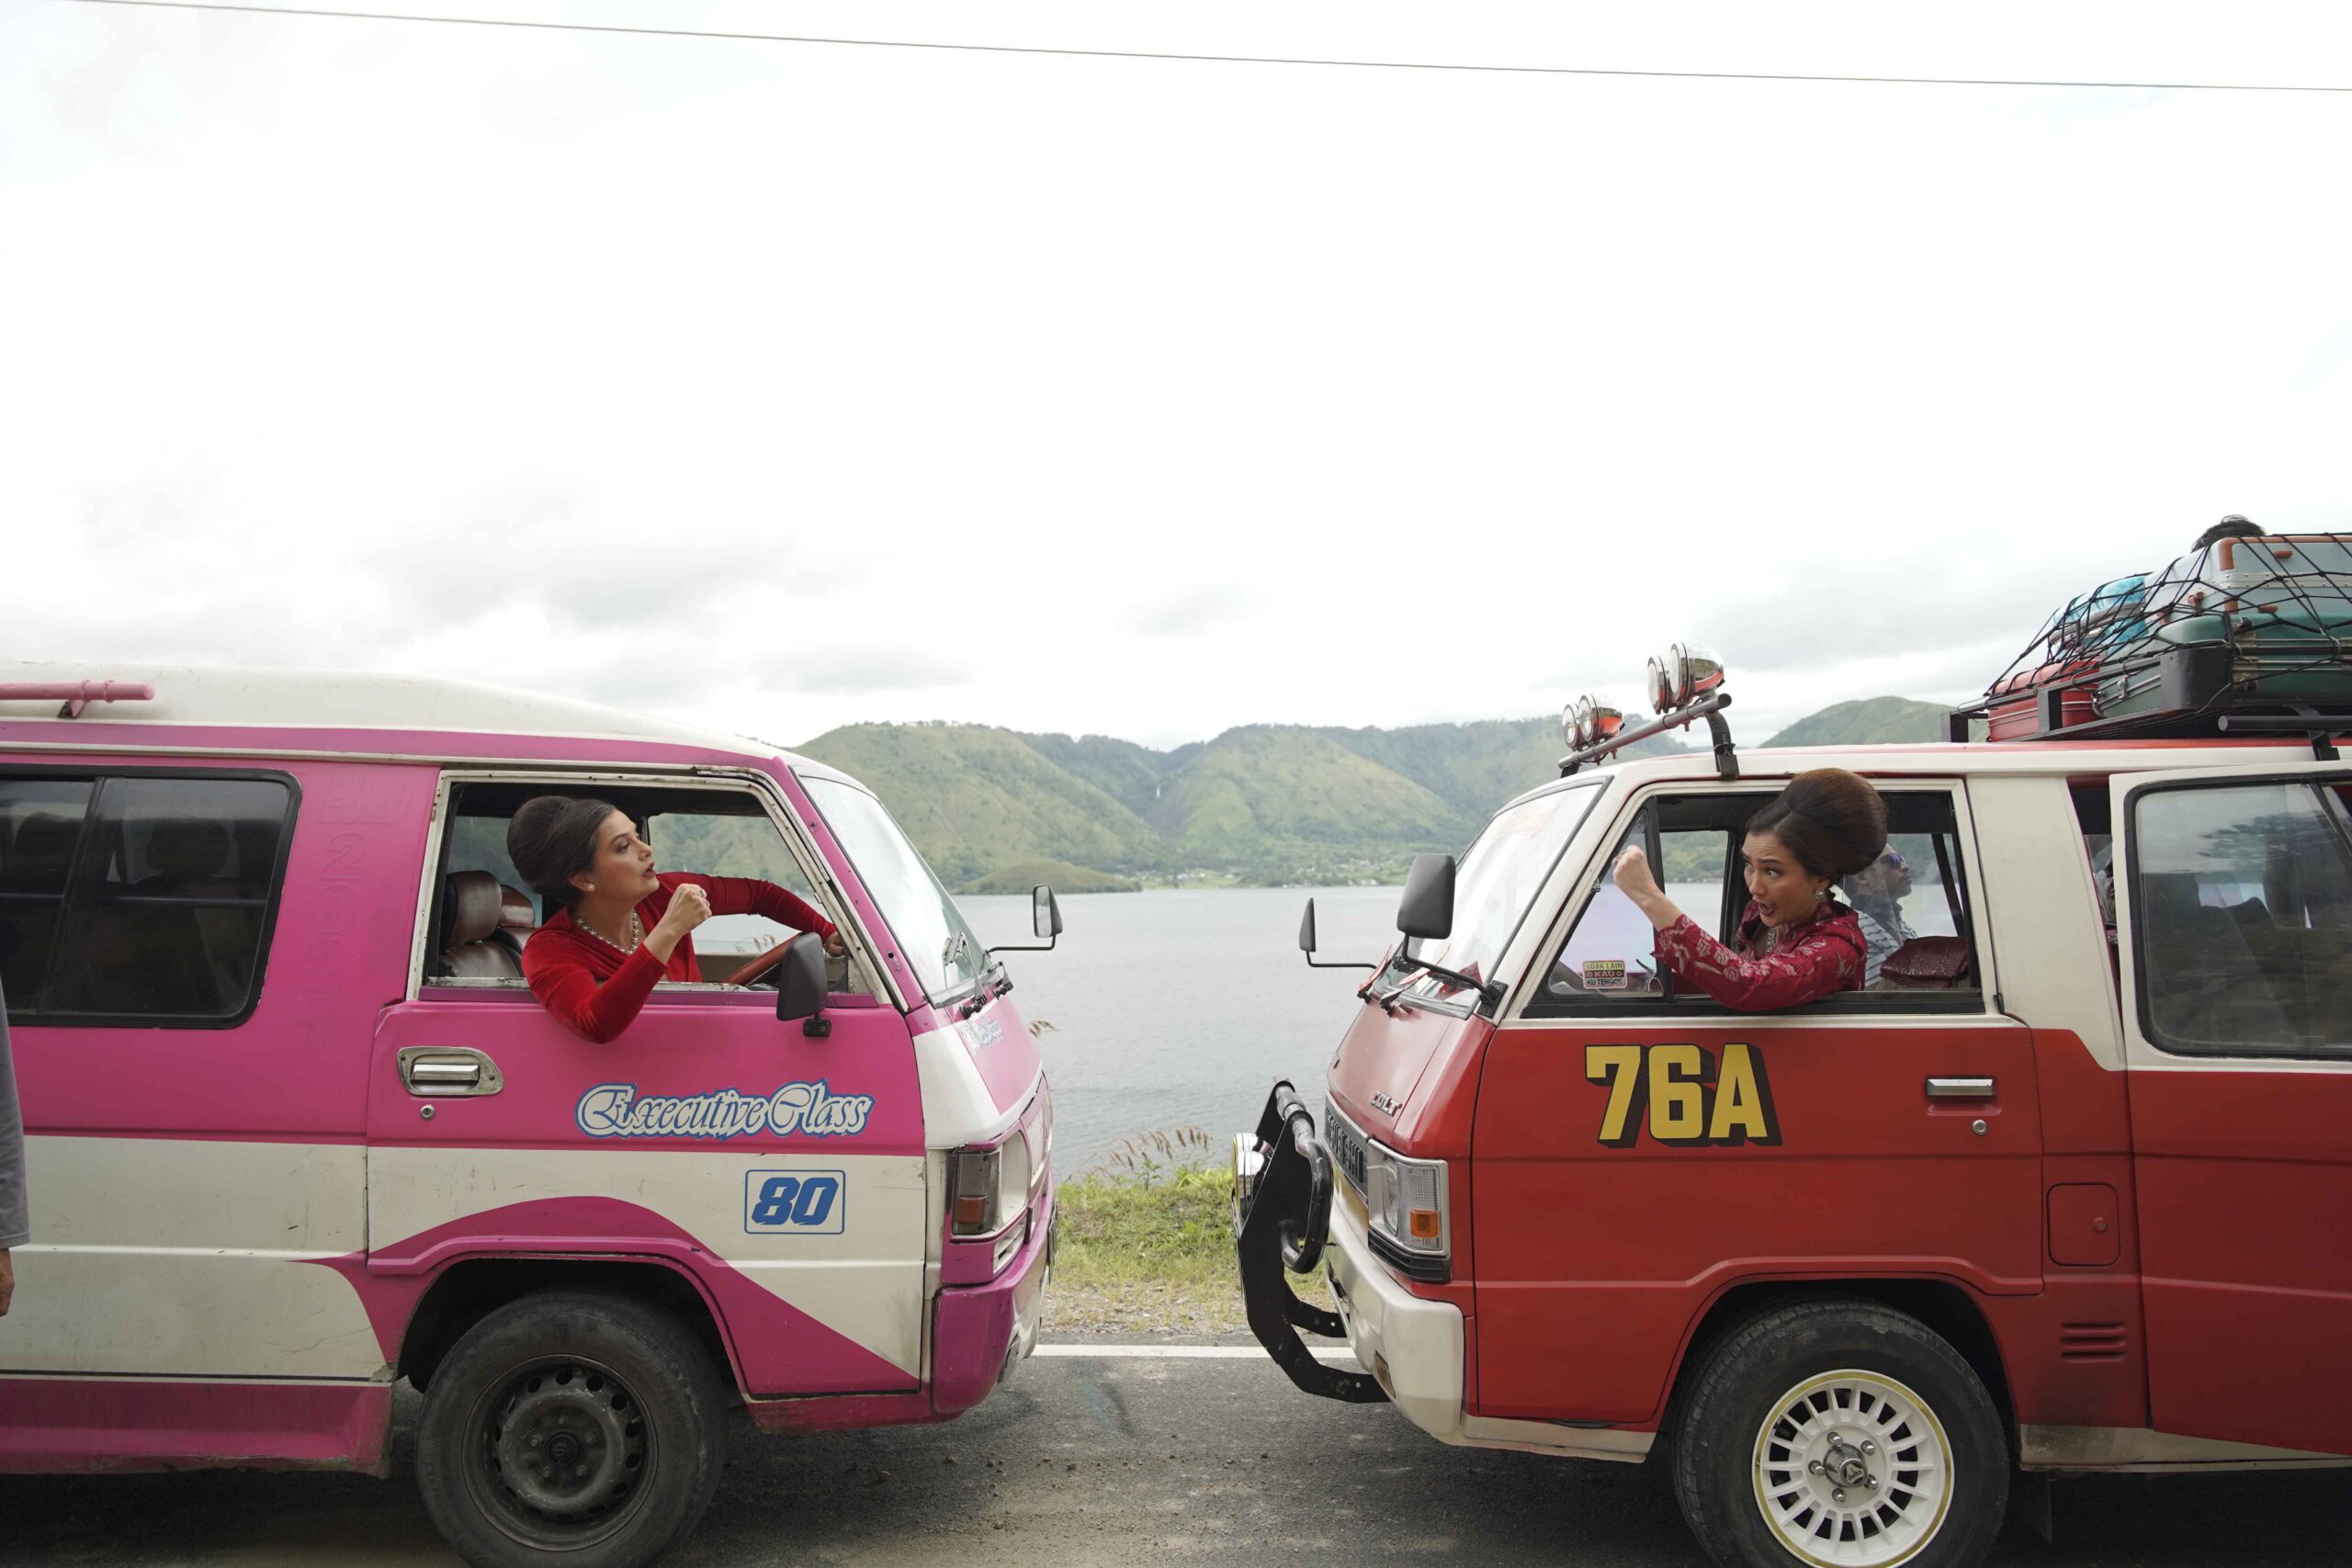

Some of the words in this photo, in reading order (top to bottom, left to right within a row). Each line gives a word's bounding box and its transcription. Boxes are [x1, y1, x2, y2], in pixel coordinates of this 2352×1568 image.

[577, 1083, 768, 1139] Executive
[766, 1077, 874, 1136] Class
[1370, 1090, 1402, 1117] COLT
[1585, 1043, 1781, 1148] 76A
[751, 1177, 840, 1225] 80
